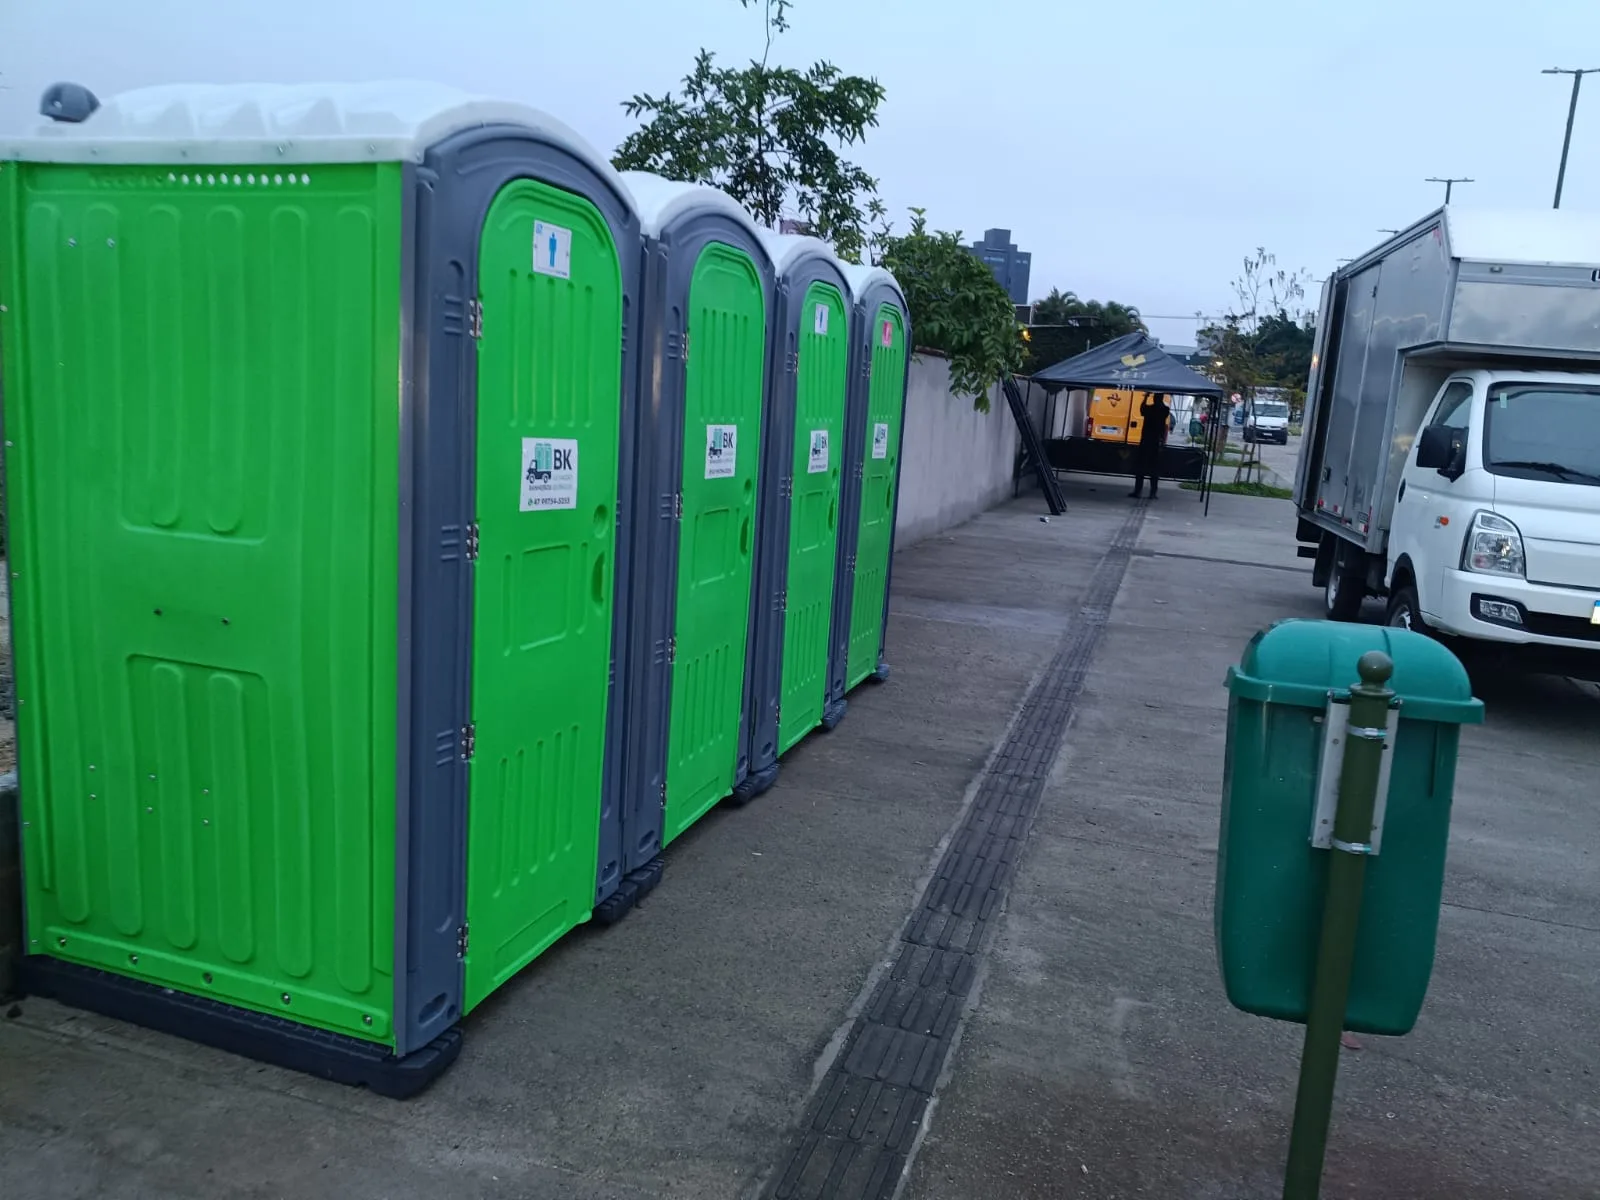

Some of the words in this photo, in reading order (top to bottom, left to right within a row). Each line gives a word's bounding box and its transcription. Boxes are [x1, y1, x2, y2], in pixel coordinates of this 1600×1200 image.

[1112, 369, 1147, 378] ZEIT
[723, 432, 734, 449] BK
[553, 448, 572, 470] BK
